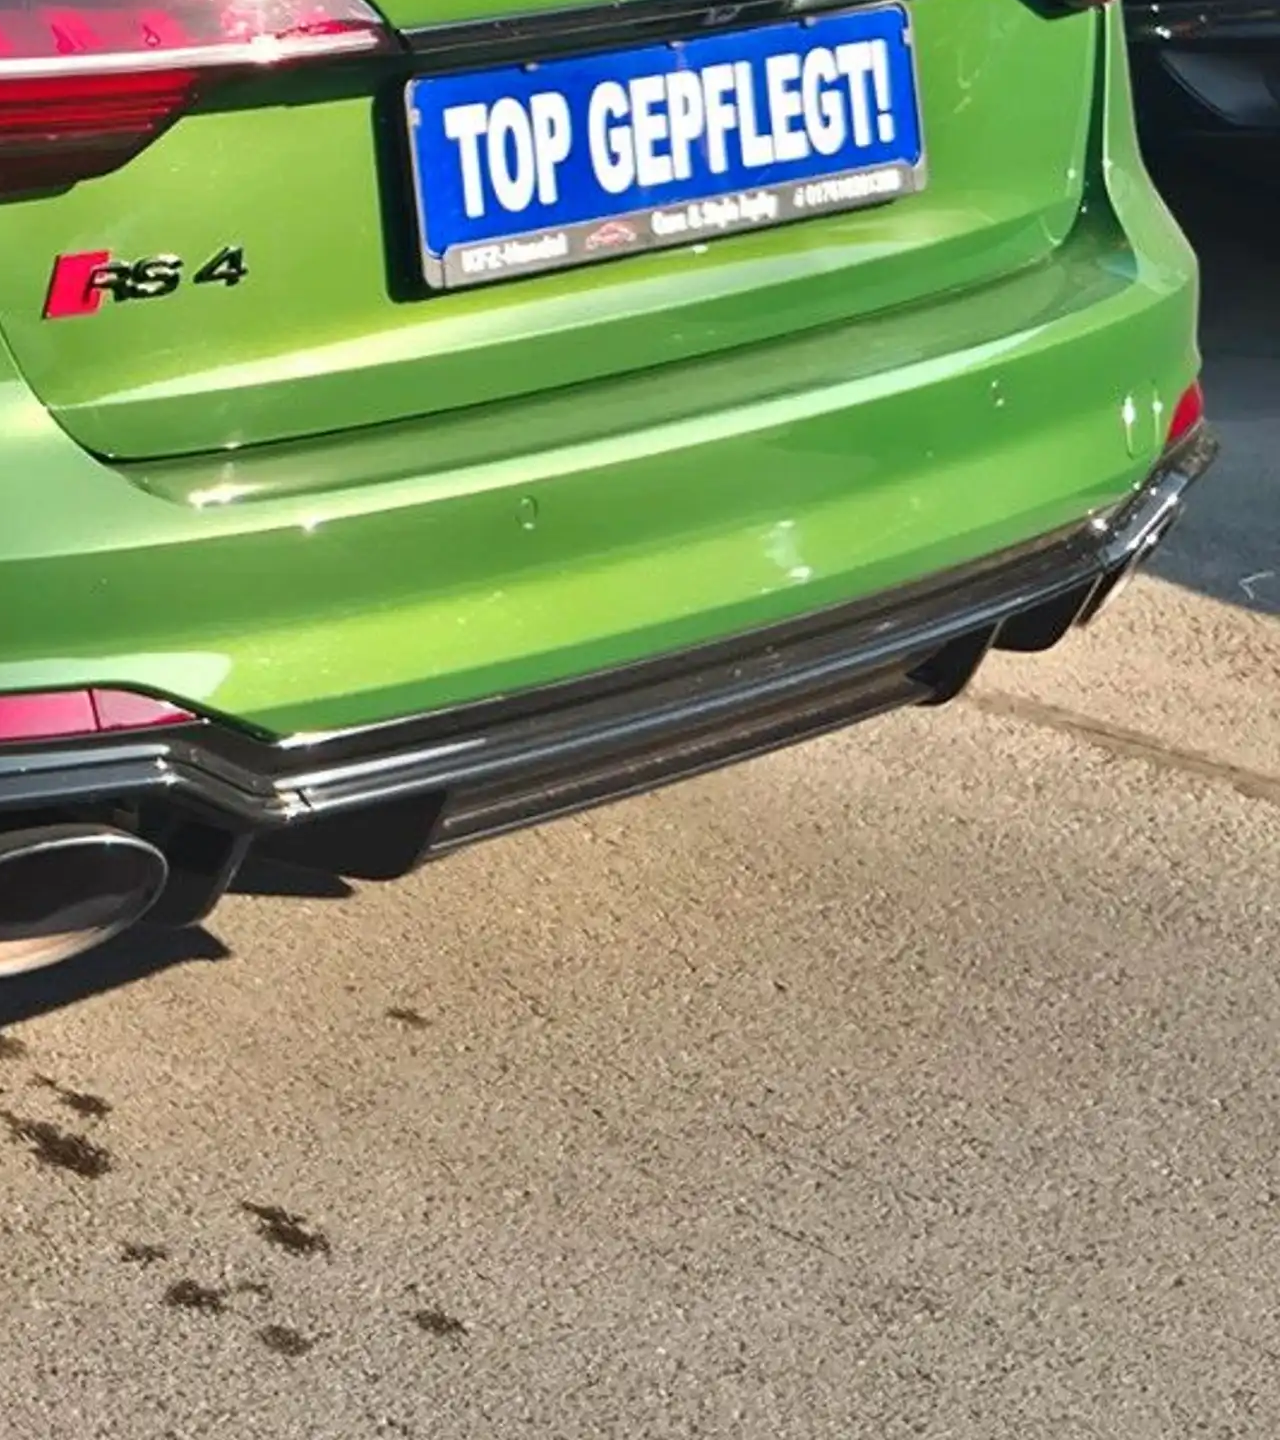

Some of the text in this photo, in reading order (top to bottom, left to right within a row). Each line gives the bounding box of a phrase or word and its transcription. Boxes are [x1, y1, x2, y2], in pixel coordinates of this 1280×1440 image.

[443, 38, 896, 219] TOP GEPFLEGT!
[66, 246, 249, 308] RS 4
